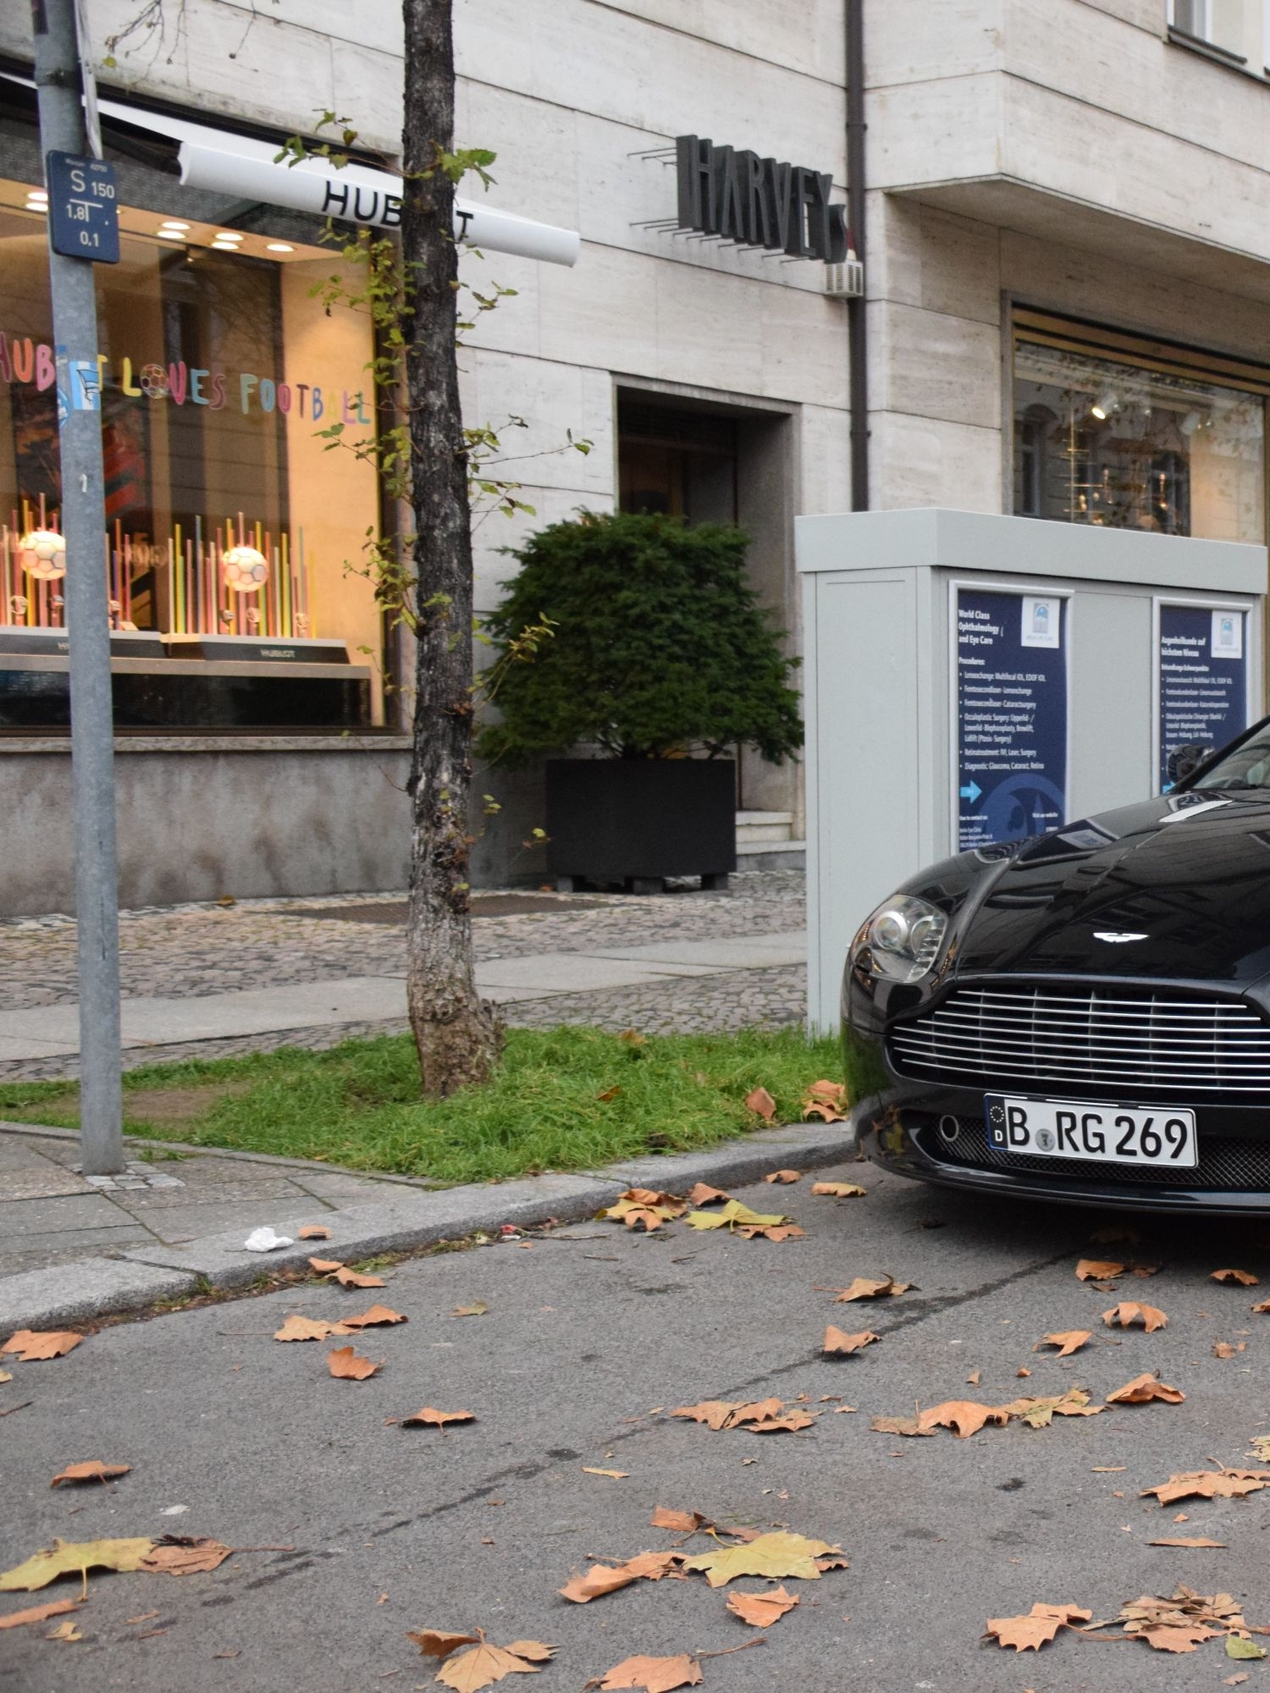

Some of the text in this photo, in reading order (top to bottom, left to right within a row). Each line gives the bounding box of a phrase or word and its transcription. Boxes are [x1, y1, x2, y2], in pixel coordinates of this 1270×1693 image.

[70, 170, 115, 199] S 150
[321, 180, 474, 243] HUBT
[239, 372, 371, 424] FOOTBALL
[958, 610, 990, 620] World Class
[970, 636, 979, 646] Eye
[980, 636, 993, 645] Care
[994, 1130, 1004, 1142] D
[1008, 1106, 1188, 1158] B RG 269
